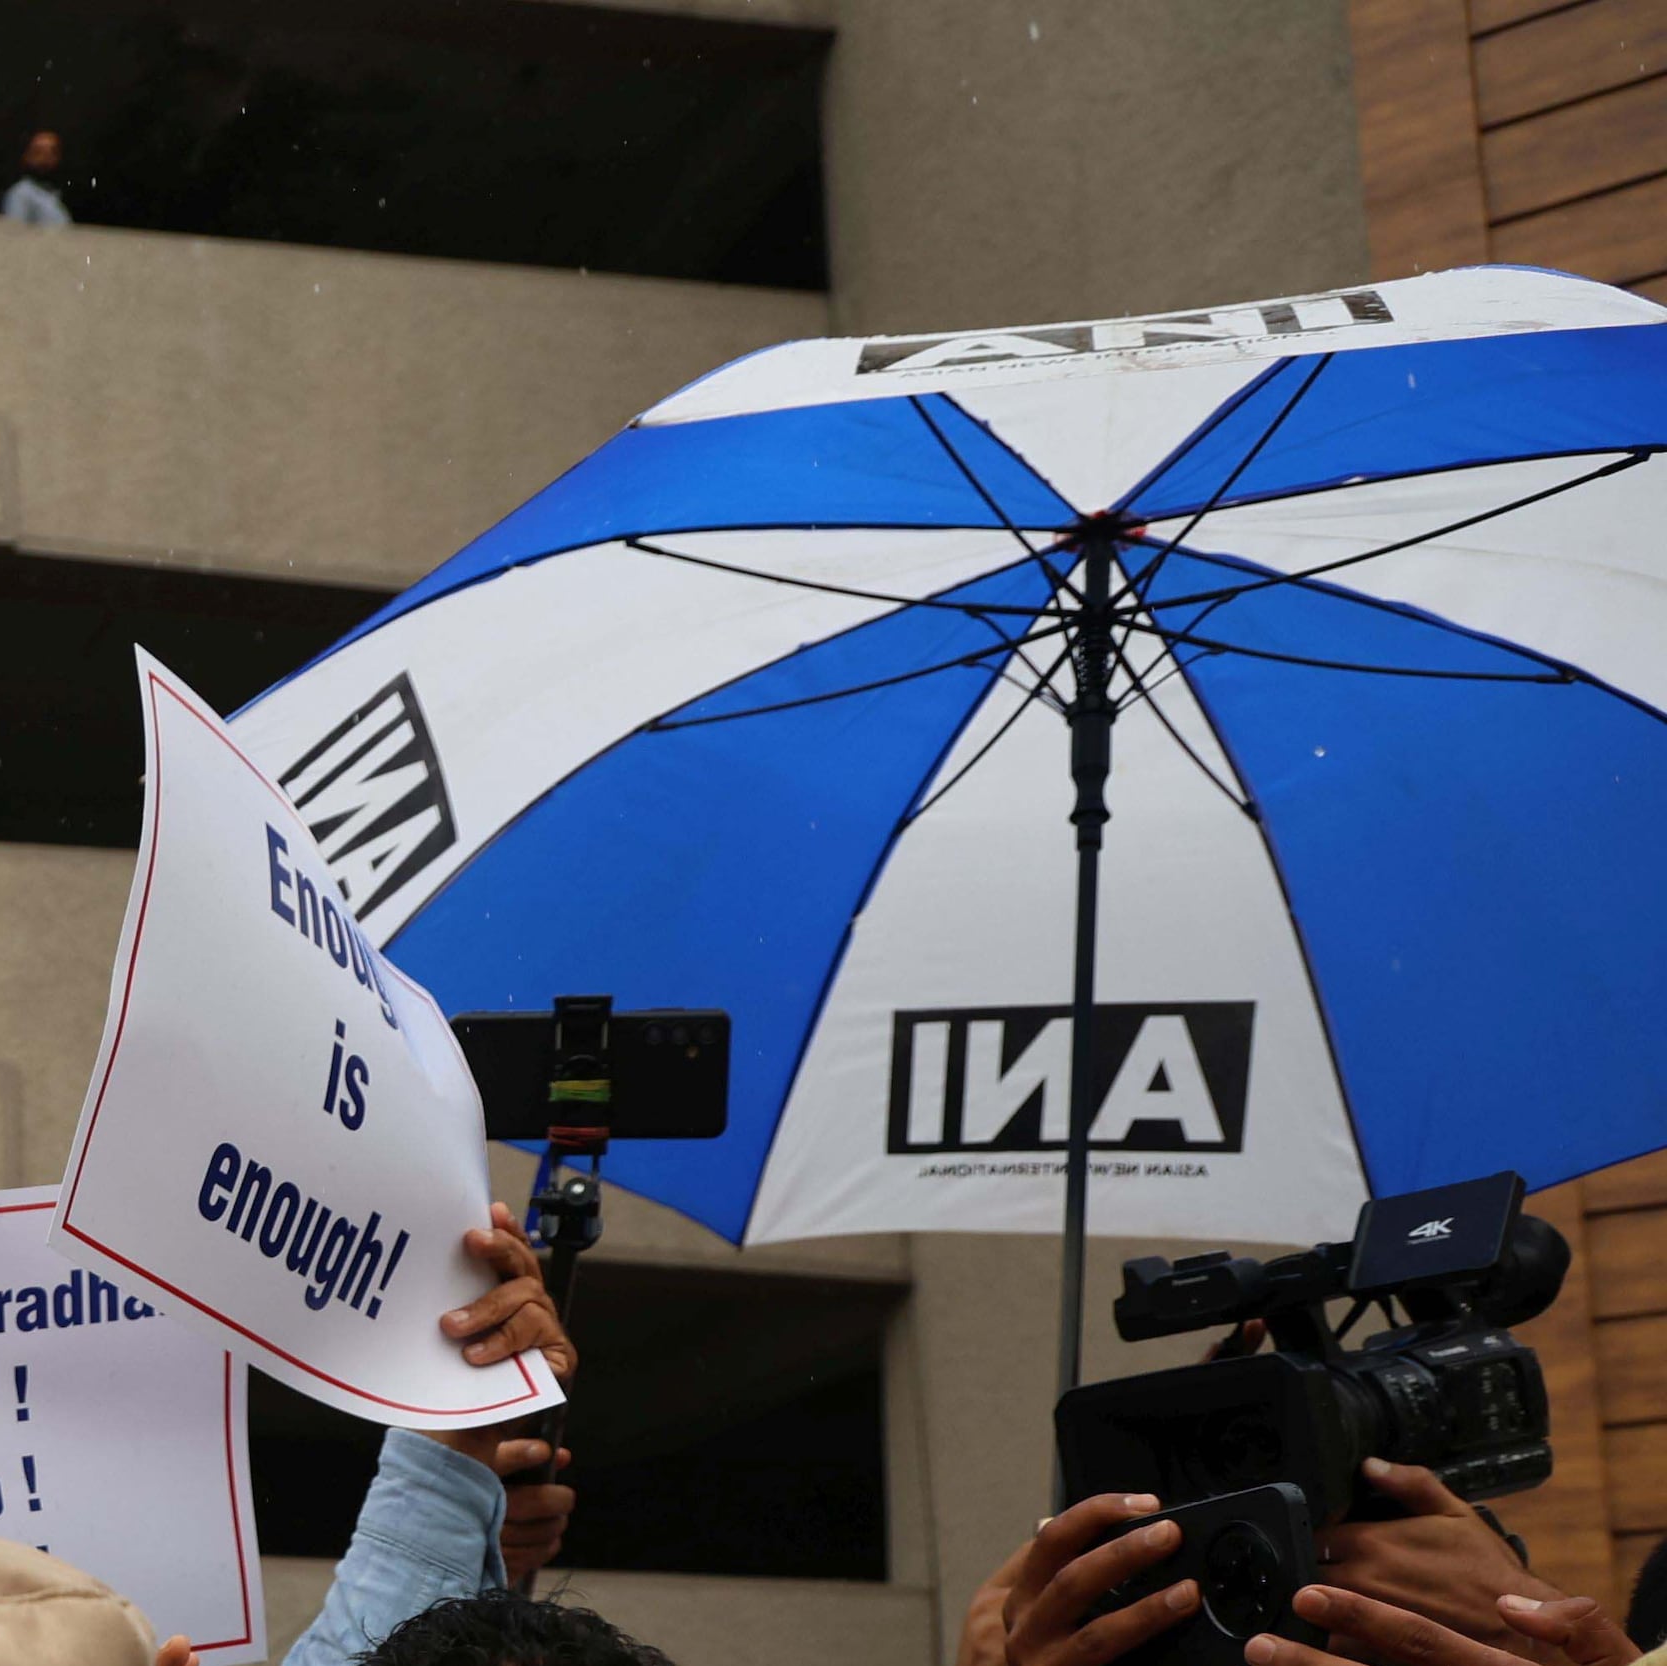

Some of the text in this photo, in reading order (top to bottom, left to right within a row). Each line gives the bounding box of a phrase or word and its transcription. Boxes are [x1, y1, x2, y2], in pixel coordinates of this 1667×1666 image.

[881, 297, 1355, 373] ANI
[266, 822, 399, 1030] Enoug
[323, 1018, 371, 1131] is
[198, 1142, 411, 1321] enough!
[1407, 1216, 1455, 1238] 4K
[14, 1365, 31, 1422] !
[21, 1455, 42, 1512] !
